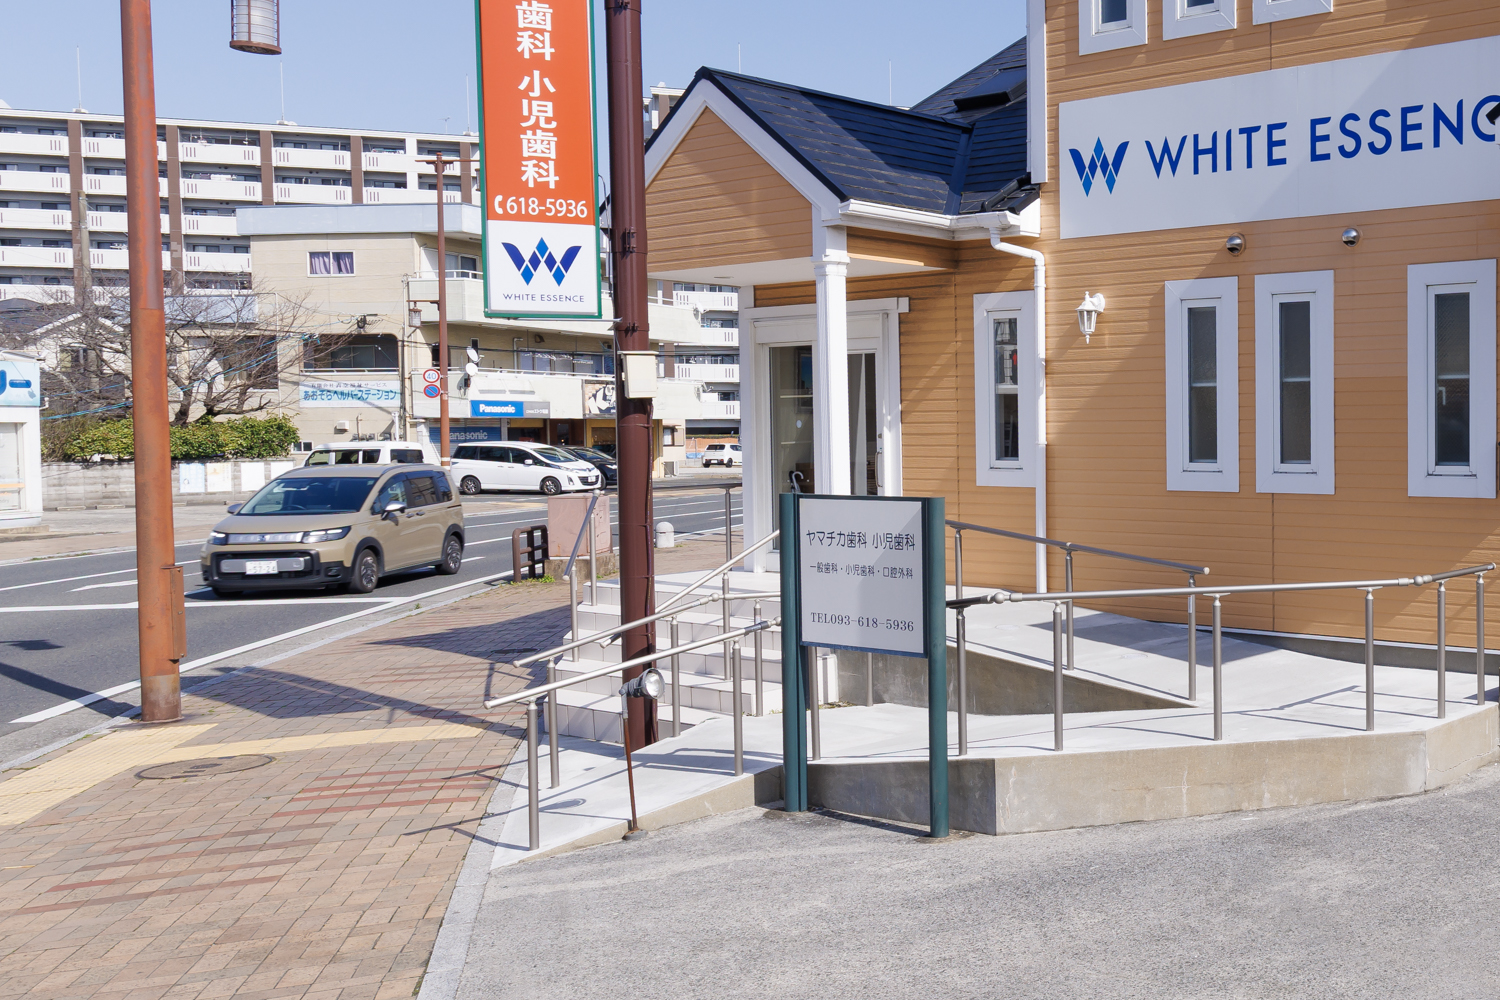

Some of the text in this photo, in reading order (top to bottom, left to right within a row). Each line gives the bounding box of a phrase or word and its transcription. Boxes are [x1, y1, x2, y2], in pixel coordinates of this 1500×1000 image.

[518, 69, 560, 189] 小児歯科
[1144, 121, 1287, 179] WHITE
[506, 196, 588, 218] 618-5936
[503, 293, 585, 303] WHITE ESSENCE
[426, 372, 437, 380] 40
[479, 404, 516, 414] Panasonic
[449, 430, 488, 440] anasonic
[806, 529, 915, 551] ヤマチカ歯科 小児歯科
[810, 561, 913, 579] 一般歯科・小児歯科・口腔外科
